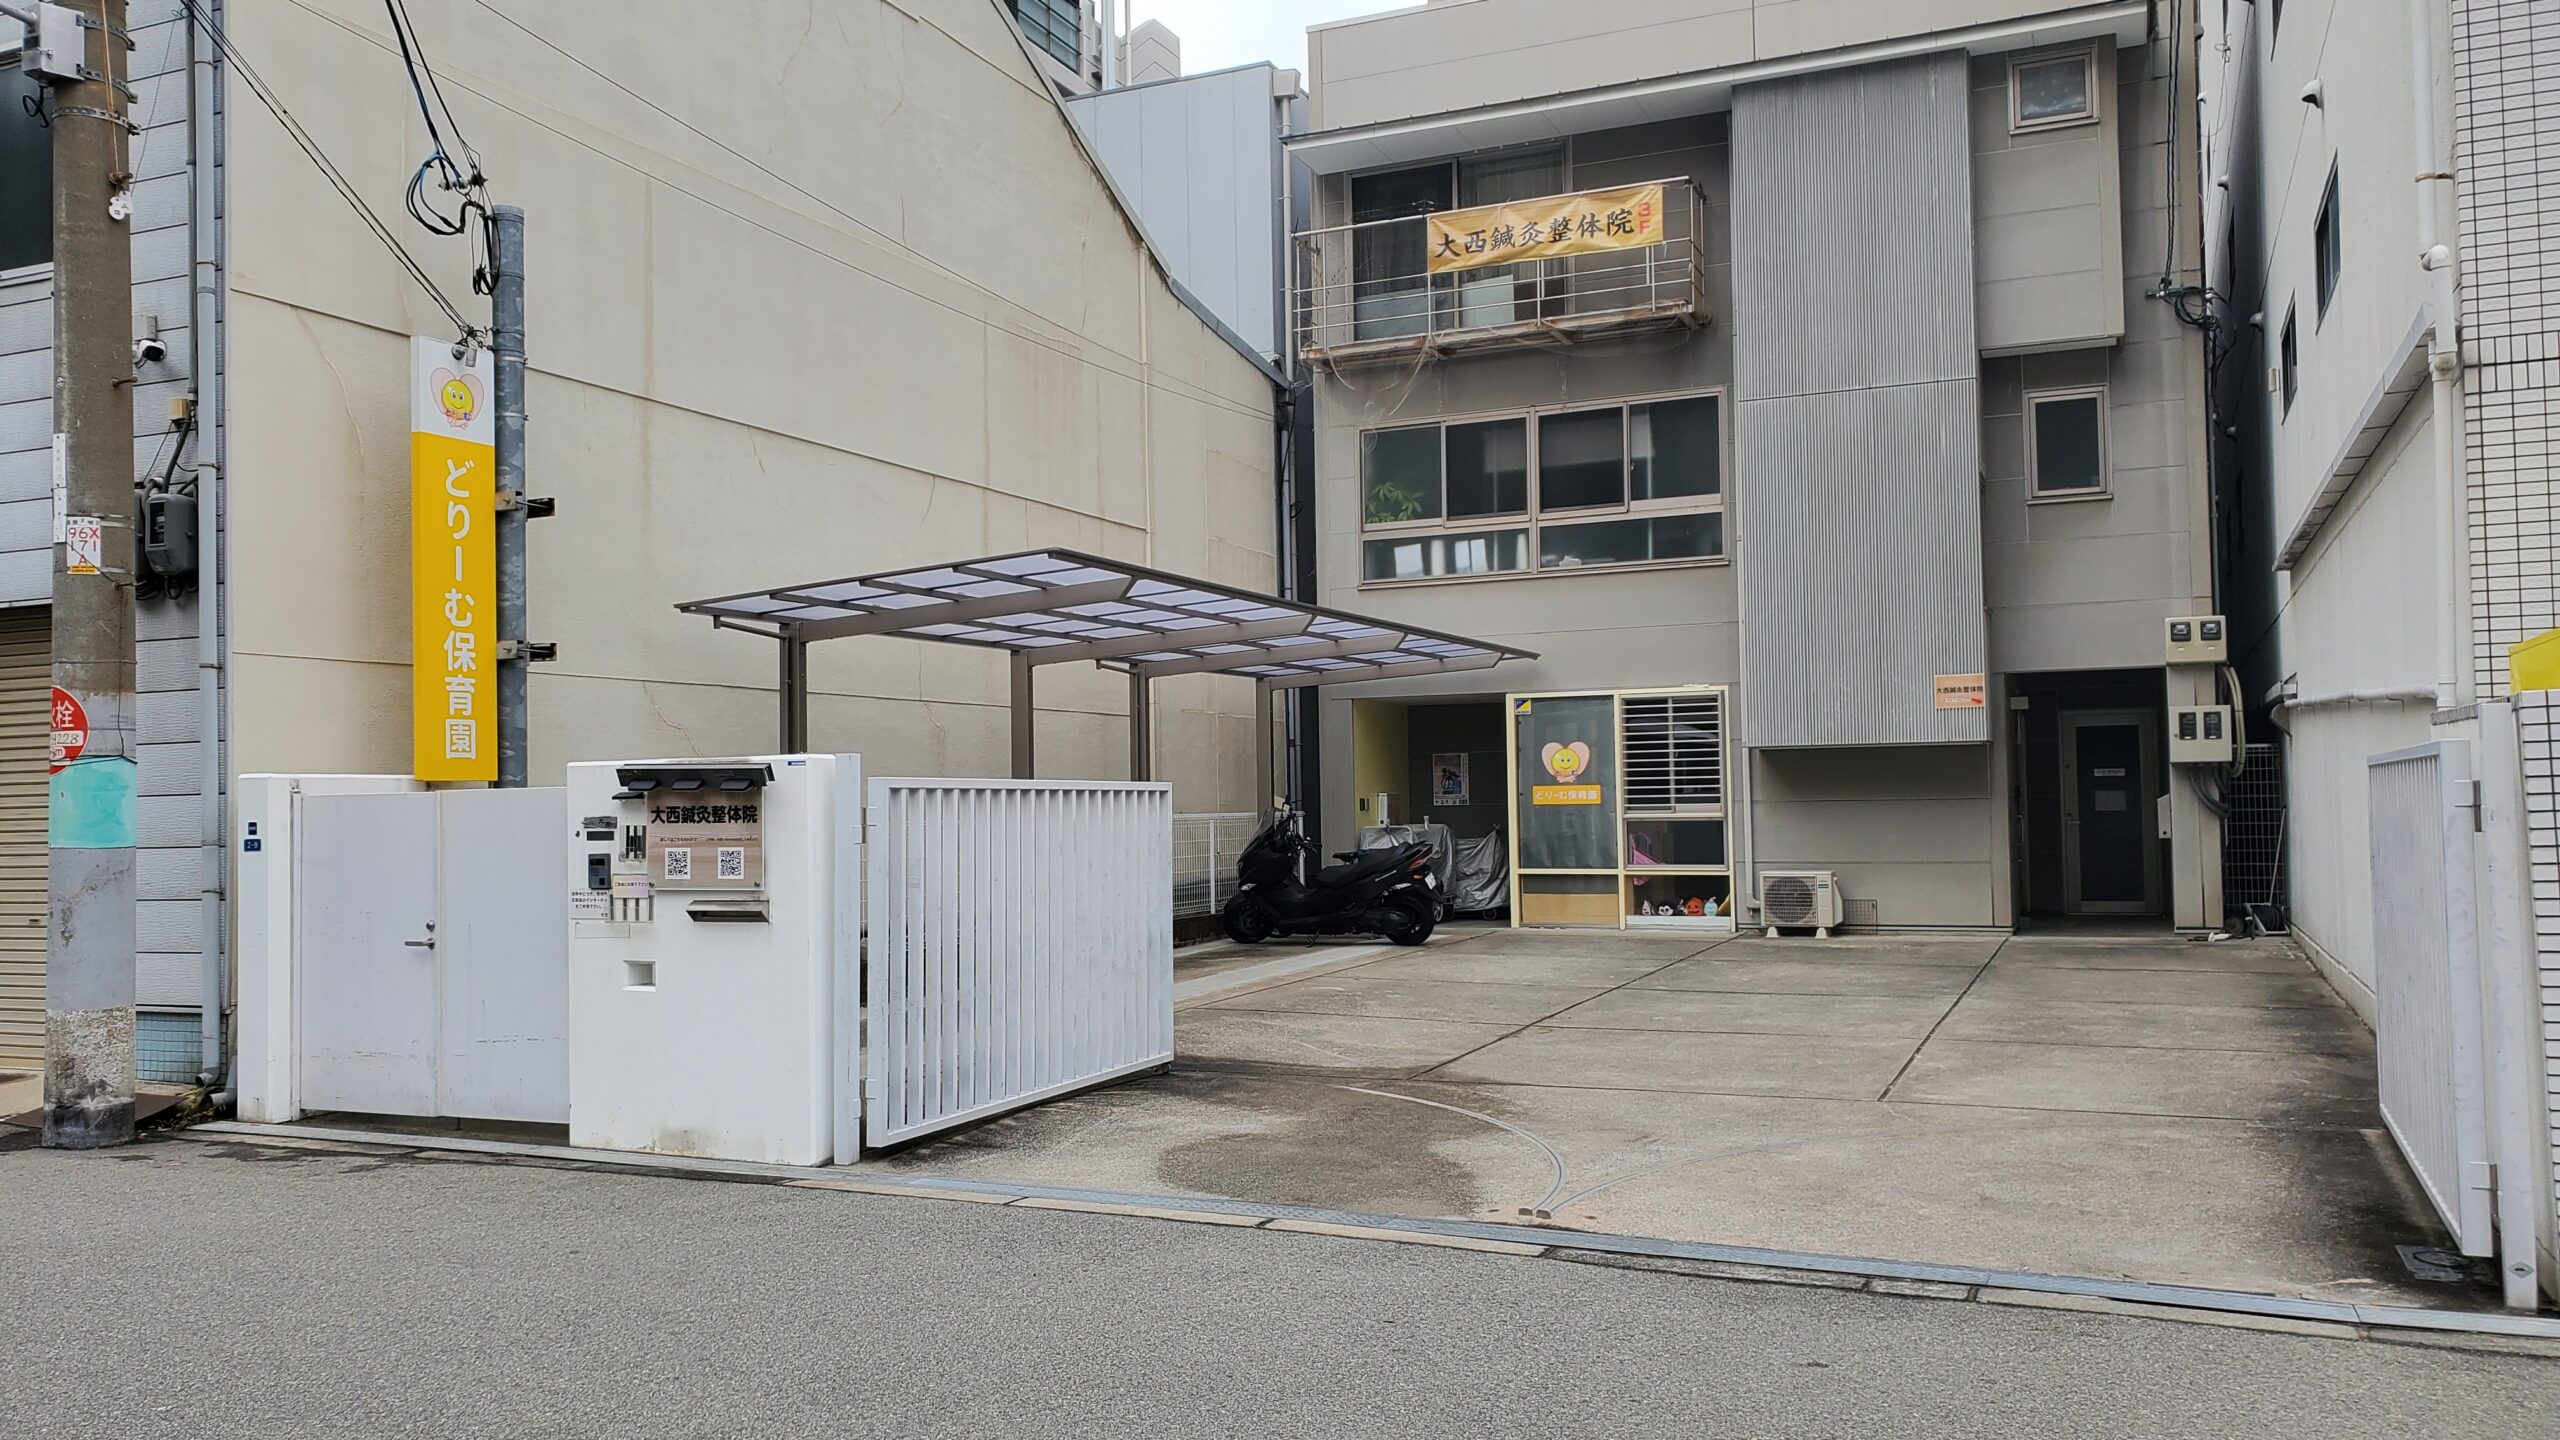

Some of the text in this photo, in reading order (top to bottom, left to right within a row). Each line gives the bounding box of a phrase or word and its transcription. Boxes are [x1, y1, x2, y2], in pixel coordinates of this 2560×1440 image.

[1434, 208, 1635, 258] 大西鍼灸整体院
[68, 527, 99, 539] 96X
[444, 458, 477, 760] どりーむ保育園
[650, 805, 758, 824] 大西鍼灸整体院
